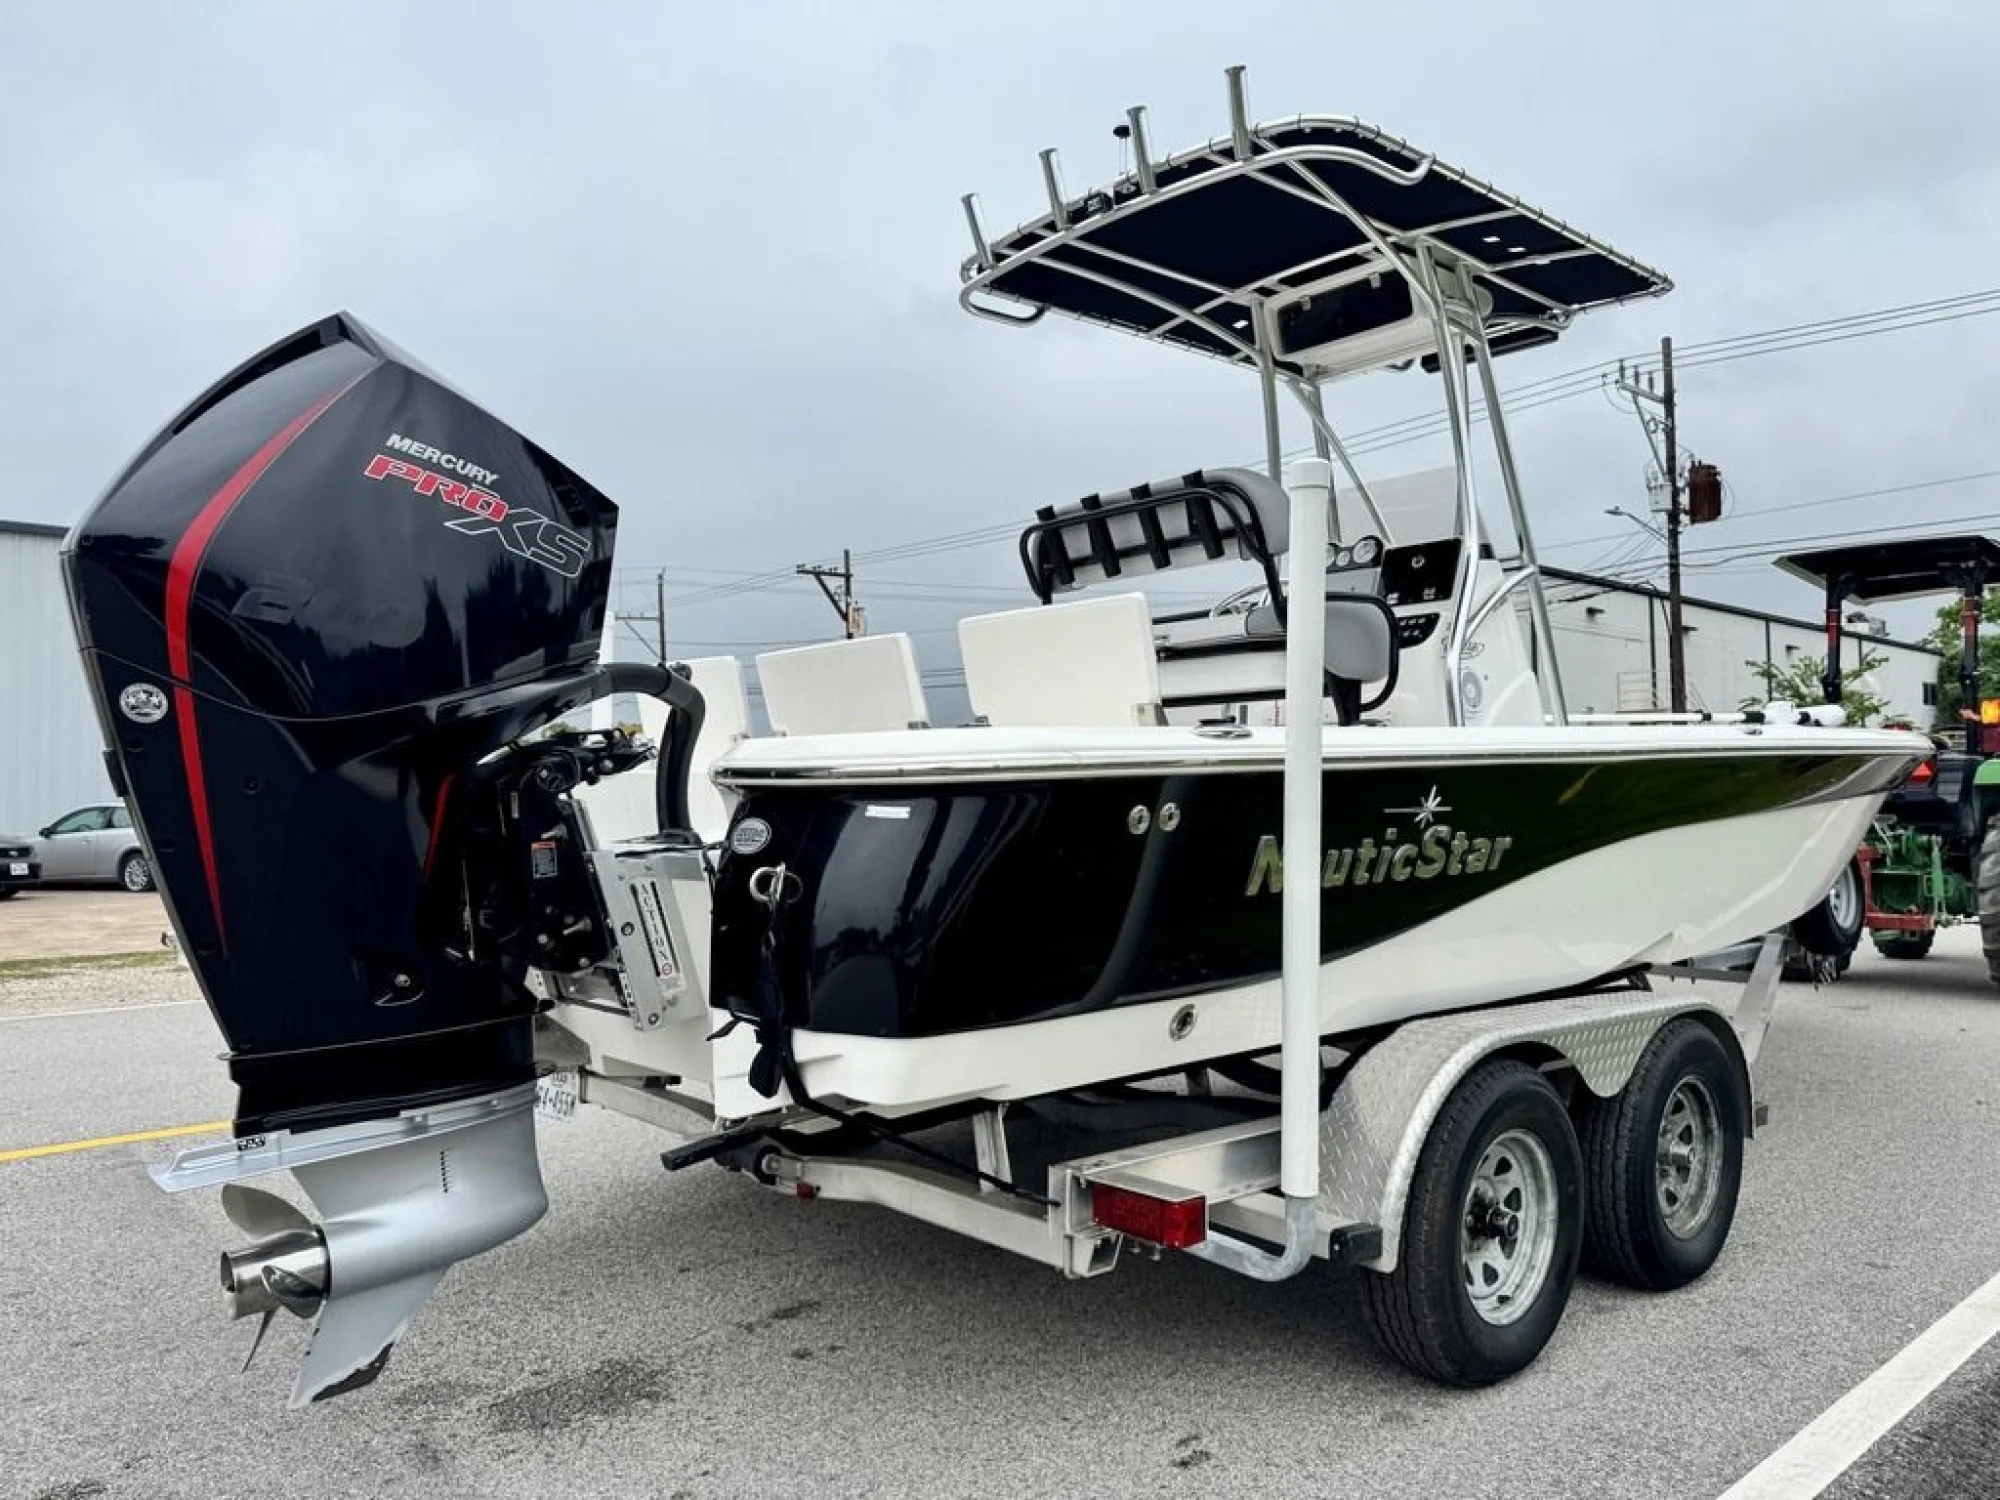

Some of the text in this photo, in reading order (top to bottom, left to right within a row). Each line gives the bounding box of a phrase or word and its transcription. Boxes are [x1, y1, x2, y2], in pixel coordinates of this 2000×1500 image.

[386, 432, 500, 486] MERCURY
[364, 454, 591, 578] PRO XS
[1245, 824, 1513, 896] NuticStar
